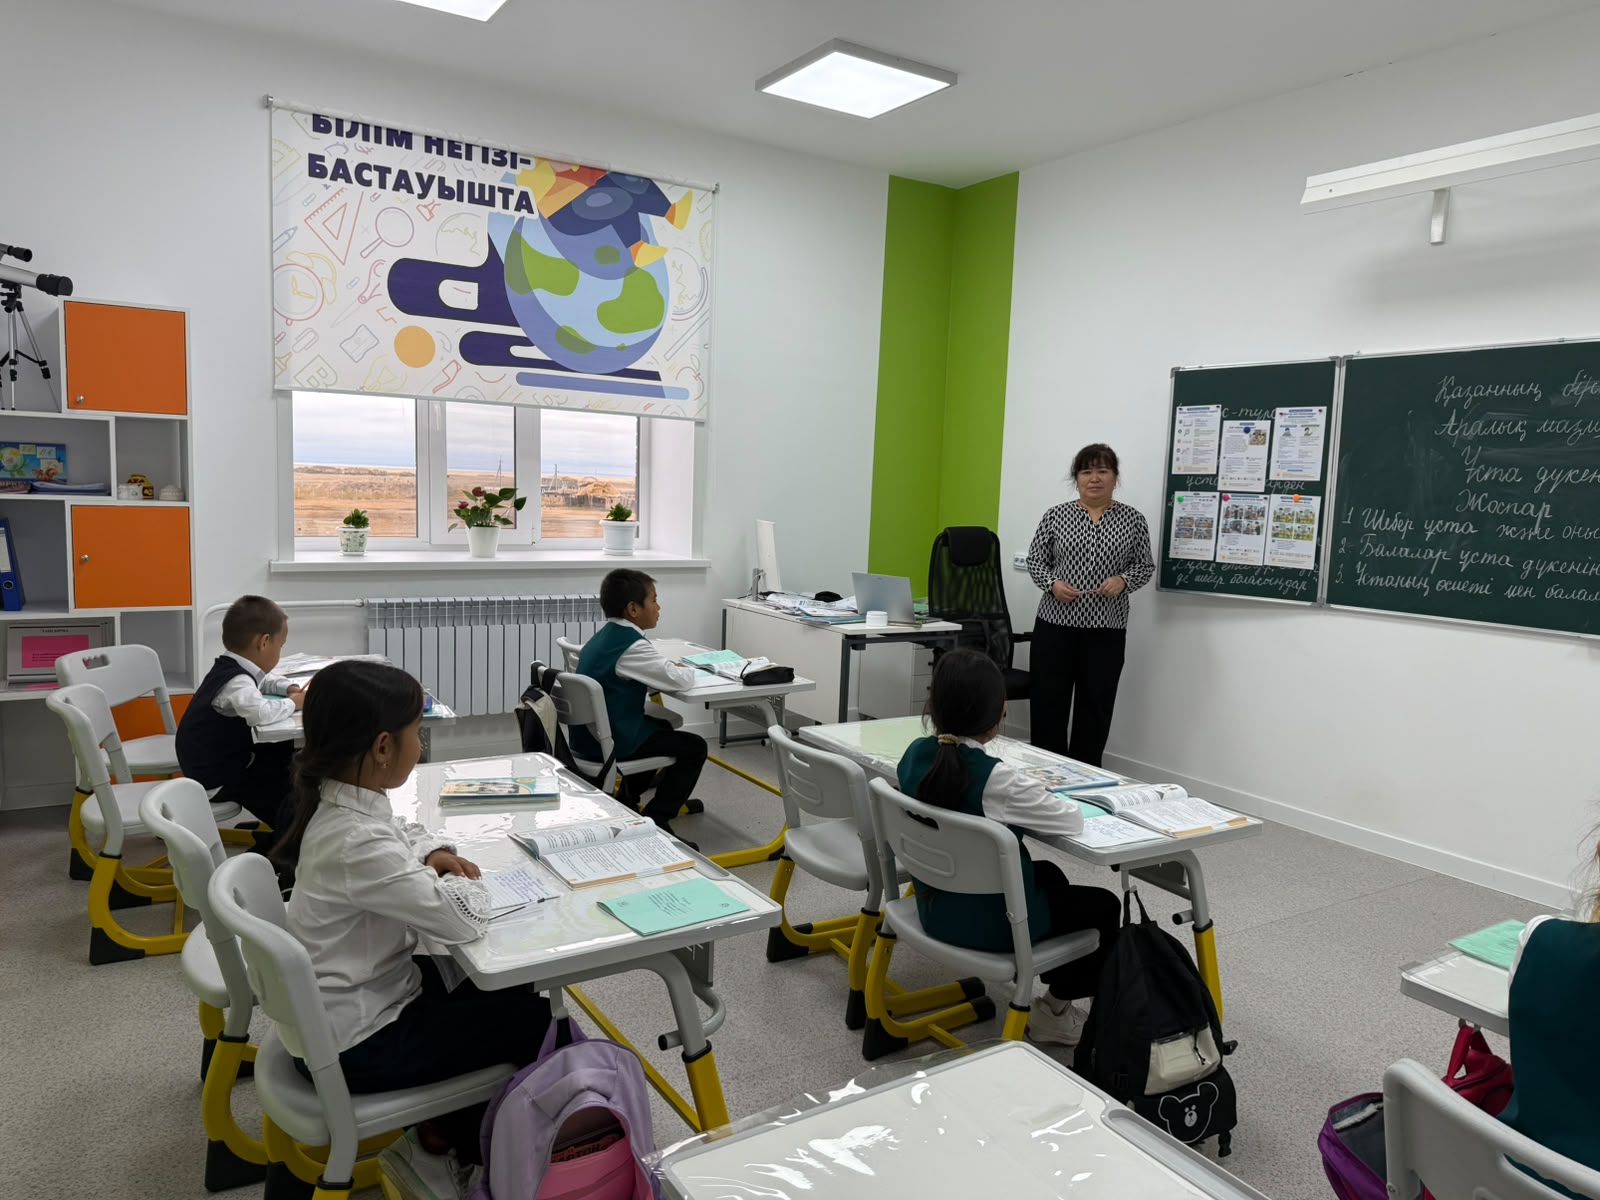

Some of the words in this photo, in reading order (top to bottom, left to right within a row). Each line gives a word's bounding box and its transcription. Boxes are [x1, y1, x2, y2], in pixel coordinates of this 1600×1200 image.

[312, 113, 413, 150] БІЛІМ
[424, 135, 531, 170] НЕГІЗІ-
[307, 153, 535, 215] БАСТАУЫШТА
[1434, 375, 1542, 410] Қазанның
[1434, 409, 1527, 448] Аралық
[1361, 507, 1415, 540] Шебер
[1455, 489, 1552, 535] Жоспар
[1360, 533, 1452, 575] Балалар
[1355, 561, 1430, 597] Ұстаның
[1504, 585, 1536, 599] мен
